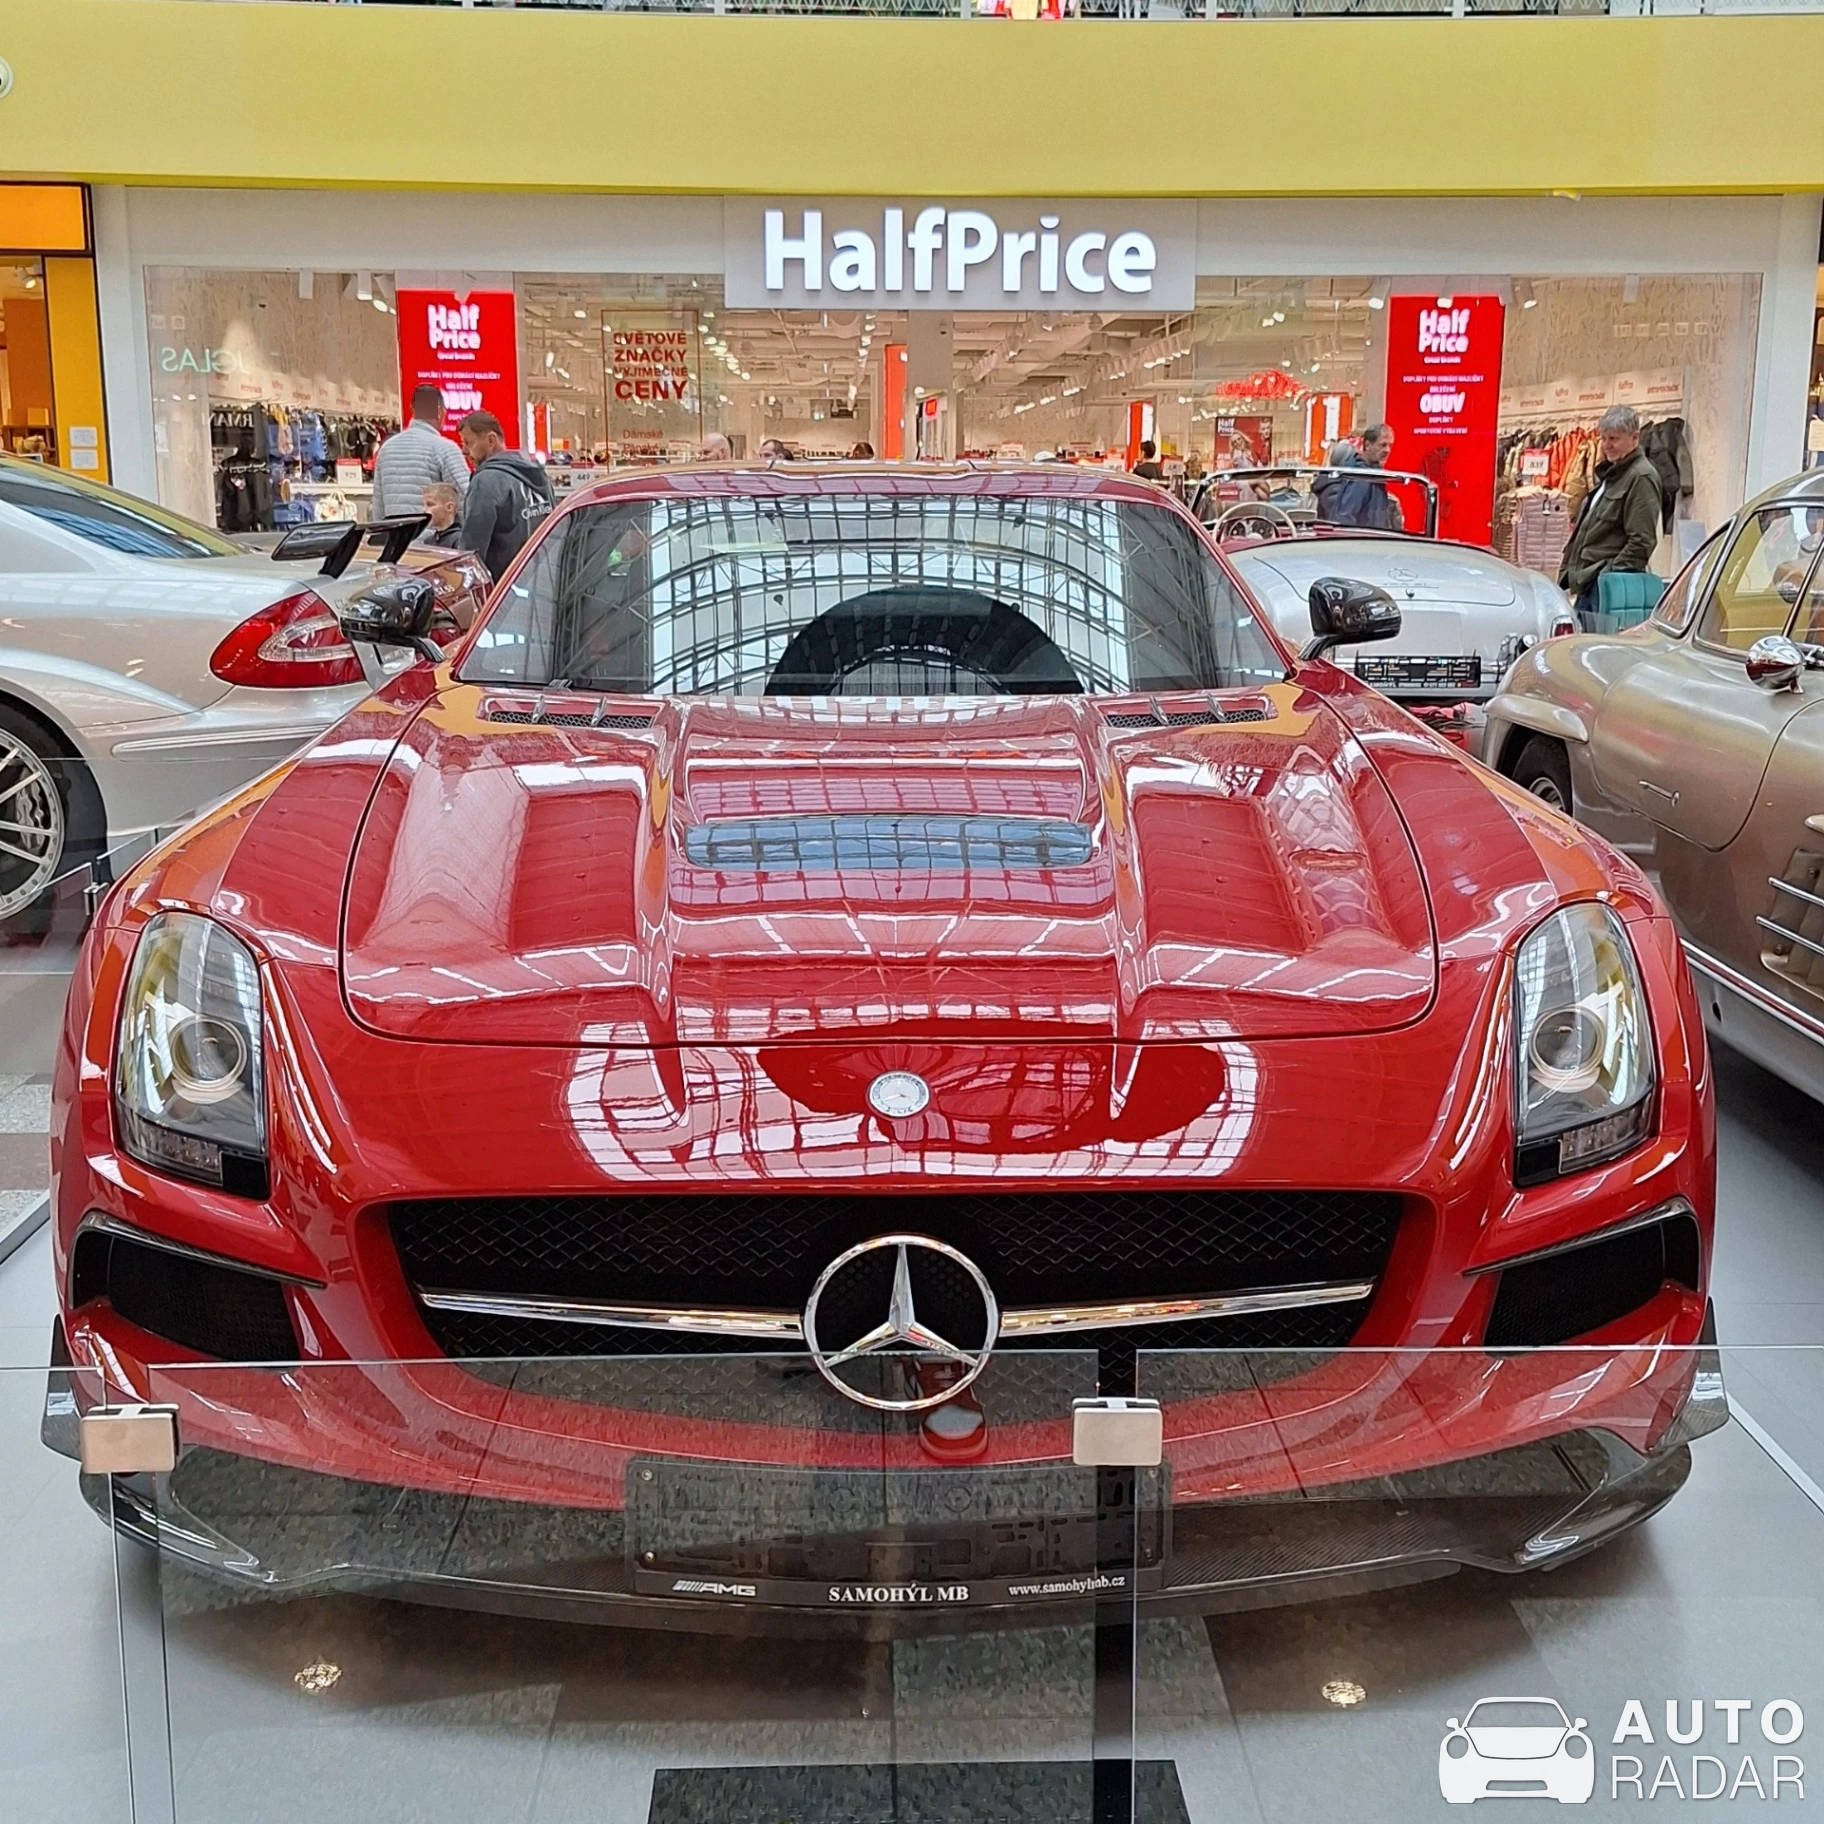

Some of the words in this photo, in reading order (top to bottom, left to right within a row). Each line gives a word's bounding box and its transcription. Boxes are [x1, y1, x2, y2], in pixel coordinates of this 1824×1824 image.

[764, 206, 1157, 293] HalfPrice
[427, 303, 480, 331] Half
[1419, 308, 1470, 334] Half
[428, 327, 481, 349] Price
[1418, 333, 1469, 353] Price
[614, 346, 687, 363] ZNAČKY
[614, 380, 687, 401] CENY
[1419, 392, 1466, 413] OBUV
[697, 1582, 757, 1597] AMG
[828, 1583, 933, 1603] SAMOHÝL
[937, 1585, 969, 1601] MB
[1008, 1575, 1126, 1596] www.samohylmb.cz
